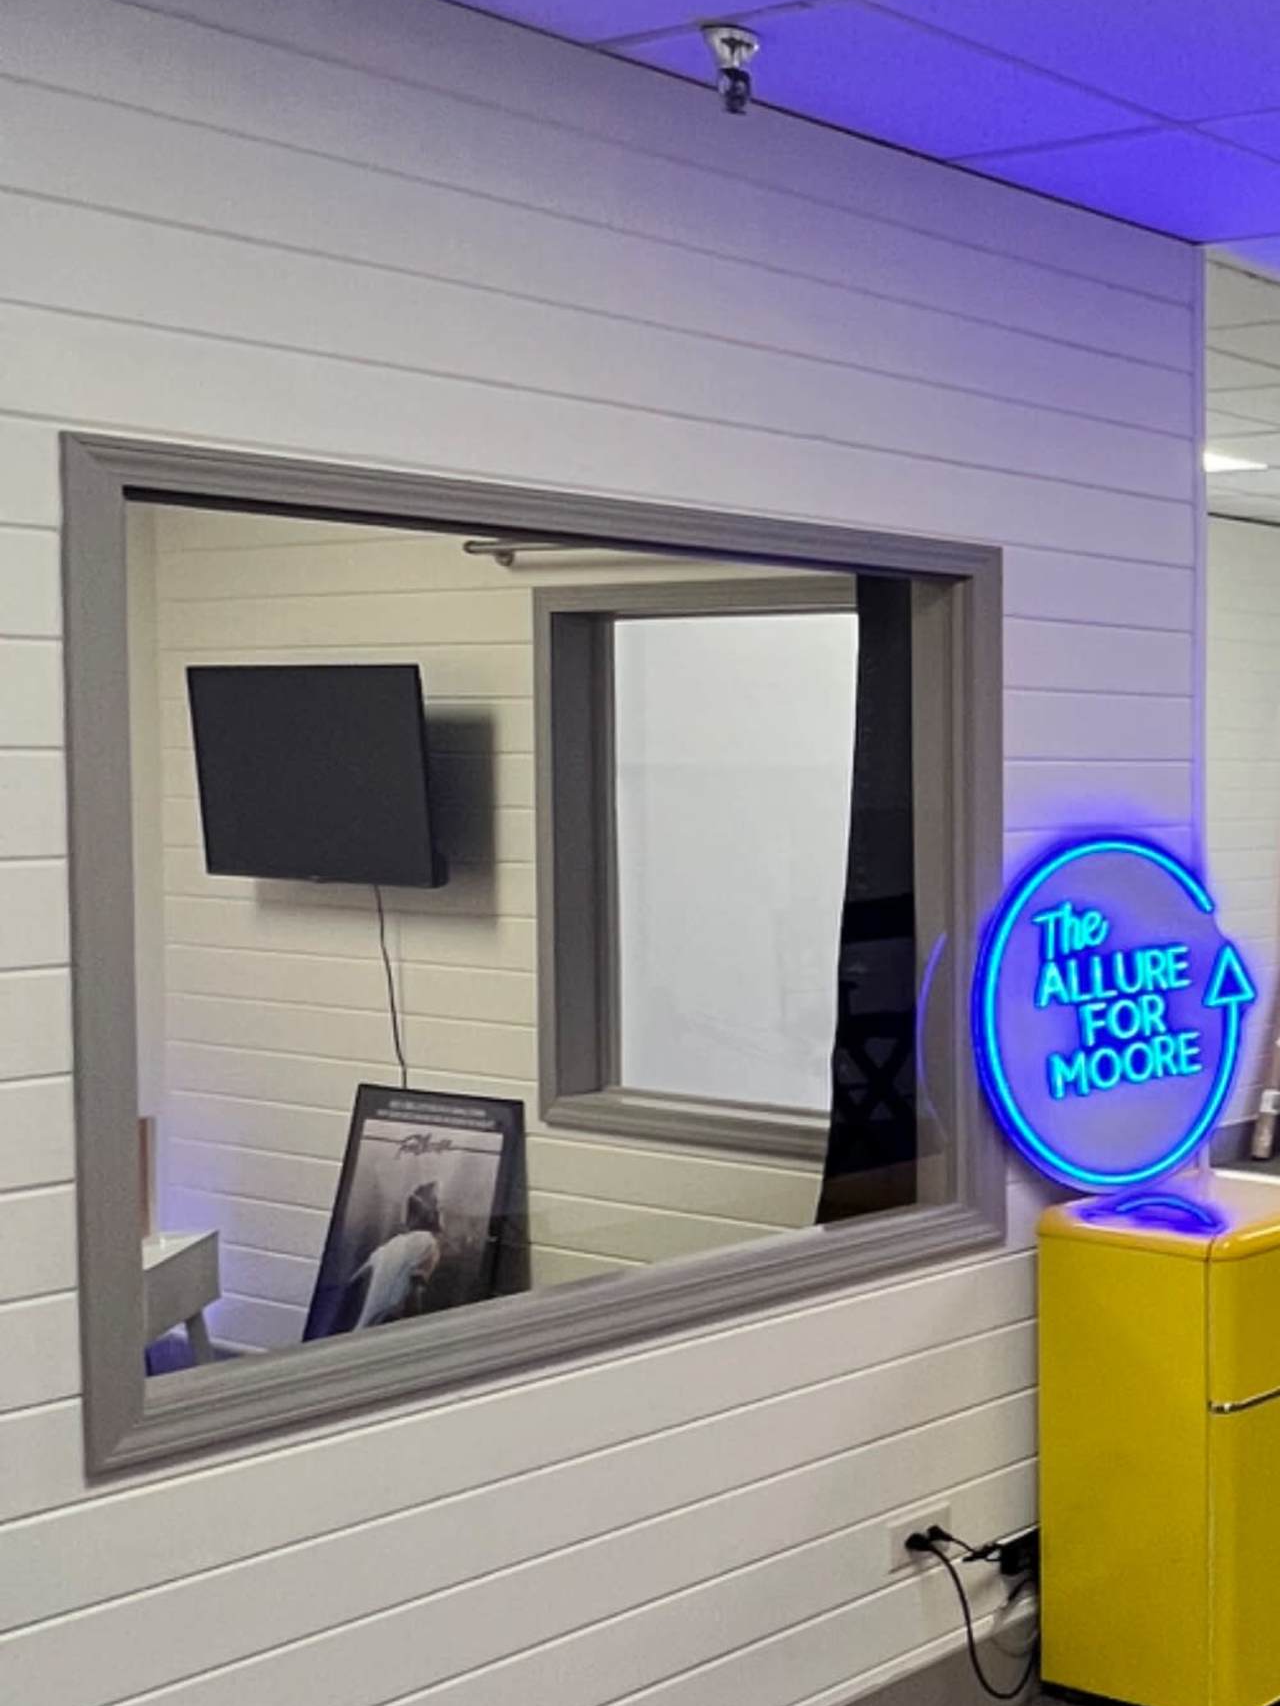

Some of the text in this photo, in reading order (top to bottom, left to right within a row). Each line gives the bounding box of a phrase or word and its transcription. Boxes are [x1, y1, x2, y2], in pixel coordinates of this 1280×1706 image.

[1032, 901, 1109, 960] The
[1036, 945, 1192, 1007] ALLURE
[1079, 994, 1167, 1047] FOR
[1048, 1031, 1203, 1099] MOORE
